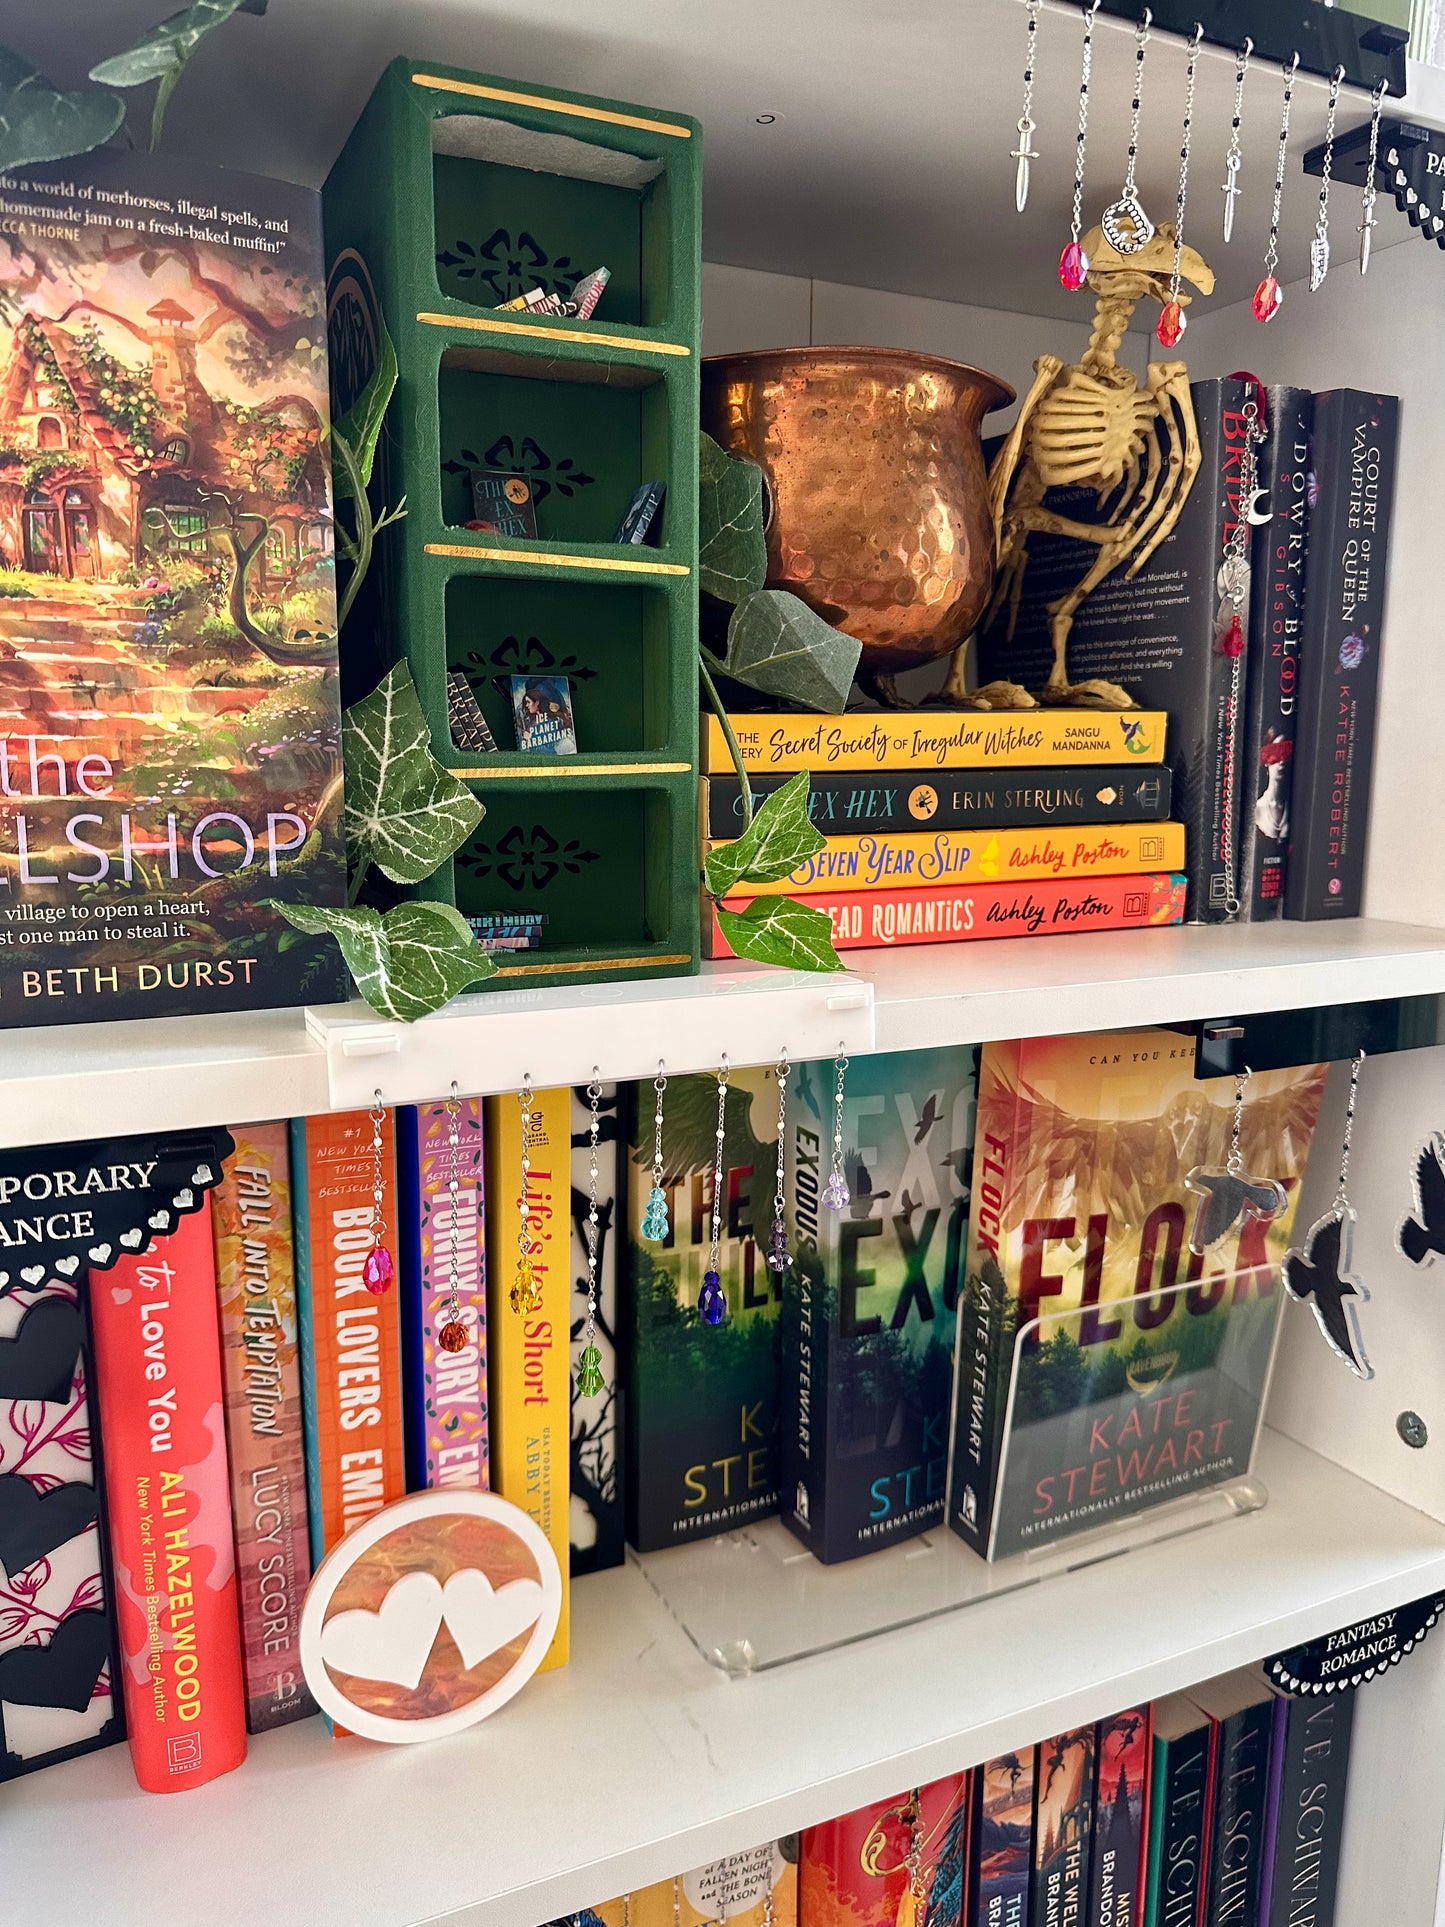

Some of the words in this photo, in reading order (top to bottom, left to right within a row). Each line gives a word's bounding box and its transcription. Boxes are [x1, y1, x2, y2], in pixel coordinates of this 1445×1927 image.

[0, 176, 17, 190] to
[20, 181, 29, 192] a
[33, 181, 75, 198] world
[78, 185, 94, 200] of
[96, 190, 175, 214] merhorses,
[177, 200, 218, 221] illegal
[220, 211, 262, 229] spells,
[264, 219, 289, 233] and
[0, 197, 81, 222] homemade
[83, 208, 112, 226] jam
[115, 218, 134, 230] on
[137, 221, 146, 232] a
[149, 219, 230, 244] fresh-baked
[0, 220, 27, 236] CCA
[30, 223, 80, 241] THORNE
[1348, 423, 1367, 530] VAMPIRE
[1363, 446, 1380, 533] COURT
[1287, 441, 1307, 576] DOWRY
[1360, 539, 1371, 562] OF
[1154, 596, 1190, 606] movement
[1158, 583, 1184, 593] without
[1271, 545, 1287, 657] GIBSON
[1341, 539, 1358, 622] QUEEN
[1357, 566, 1368, 602] THE
[1147, 646, 1183, 657] everything
[1280, 617, 1298, 716] BLOOD
[521, 727, 573, 750] BARBARIANS
[529, 719, 559, 736] PLANET
[535, 712, 549, 724] ICE
[736, 732, 760, 744] THE
[1064, 727, 1100, 738] SANGU
[1217, 708, 1225, 730] New
[1335, 684, 1350, 762] KATEE
[769, 724, 827, 763] Secret
[827, 724, 891, 762] Society
[893, 738, 908, 750] OF
[910, 723, 983, 765] Irregular
[984, 726, 1044, 756] Witches
[1052, 740, 1111, 751] MANDANNA
[1216, 731, 1224, 752] York
[0, 734, 115, 799] the
[807, 791, 840, 820] EX
[843, 789, 898, 819] HEX
[952, 791, 995, 810] ERIN
[1004, 787, 1084, 814] STERLING
[1211, 781, 1221, 831] Bestselling
[1327, 772, 1344, 869] ROBERT
[1008, 840, 1066, 873] Ashley
[1071, 838, 1130, 867] Poston
[1211, 831, 1220, 862] Author
[4, 903, 66, 924] village
[71, 904, 90, 919] to
[94, 905, 139, 921] open
[144, 904, 155, 916] a
[158, 899, 210, 917] heart,
[818, 905, 862, 939] EAD
[986, 895, 1046, 932] Ashley
[1052, 894, 1113, 923] Poston
[19, 930, 54, 945] one
[58, 928, 100, 943] man
[104, 925, 122, 940] to
[127, 922, 168, 939] steal
[173, 922, 191, 938] it.
[23, 966, 118, 998] BETH
[138, 958, 258, 991] DURST
[1089, 1054, 1121, 1065] CAN
[1132, 1051, 1160, 1062] YOU
[316, 1146, 347, 1158] NEW
[343, 1127, 361, 1138] #1
[0, 1161, 158, 1204] PORARY
[334, 1161, 371, 1175] TIMES
[795, 1124, 820, 1255] EXODUS
[234, 1165, 272, 1227] FALL
[976, 1132, 1006, 1266] FLOCK
[333, 1206, 376, 1300] BOOK
[432, 1188, 478, 1293] FUNNY
[135, 1259, 177, 1296] to
[243, 1238, 270, 1295] INTO
[1018, 1177, 1299, 1350] FLOCK
[800, 1272, 813, 1340] KATE
[975, 1281, 992, 1346] KATE
[140, 1300, 170, 1382] Love
[243, 1297, 284, 1436] TEMPTATION
[336, 1305, 383, 1432] LOVERS
[523, 1320, 553, 1407] Short
[147, 1386, 177, 1453] You
[797, 1344, 813, 1461] STEWART
[967, 1348, 988, 1466] STEWART
[1089, 1389, 1198, 1454] KATE
[542, 1427, 550, 1448] USA
[526, 1437, 541, 1494] ABBY
[543, 1450, 551, 1487] TODAY
[1032, 1419, 1233, 1515] STEWART
[136, 1476, 151, 1510] New
[159, 1471, 187, 1518] ALI
[252, 1466, 284, 1544] LUCY
[1019, 1494, 1121, 1536] INTERNATIONALLY
[1123, 1470, 1190, 1500] BESTSELLING
[1192, 1456, 1234, 1477] AUTHOR
[139, 1513, 156, 1546] York
[143, 1550, 157, 1592] Times
[164, 1527, 202, 1722] HAZELWOOD
[258, 1554, 290, 1656] SCORE
[146, 1595, 164, 1671] Bestselling
[1326, 1612, 1397, 1652] FANTASY
[1319, 1634, 1398, 1677] ROMANCE
[152, 1675, 168, 1723] Author
[270, 1698, 301, 1713] BLOOM
[169, 1760, 202, 1773] BERKLEY
[729, 1852, 751, 1867] DAY
[754, 1847, 769, 1858] OF
[1064, 1840, 1081, 1882] THE
[701, 1889, 716, 1900] and
[1063, 1884, 1079, 1927] WEL
